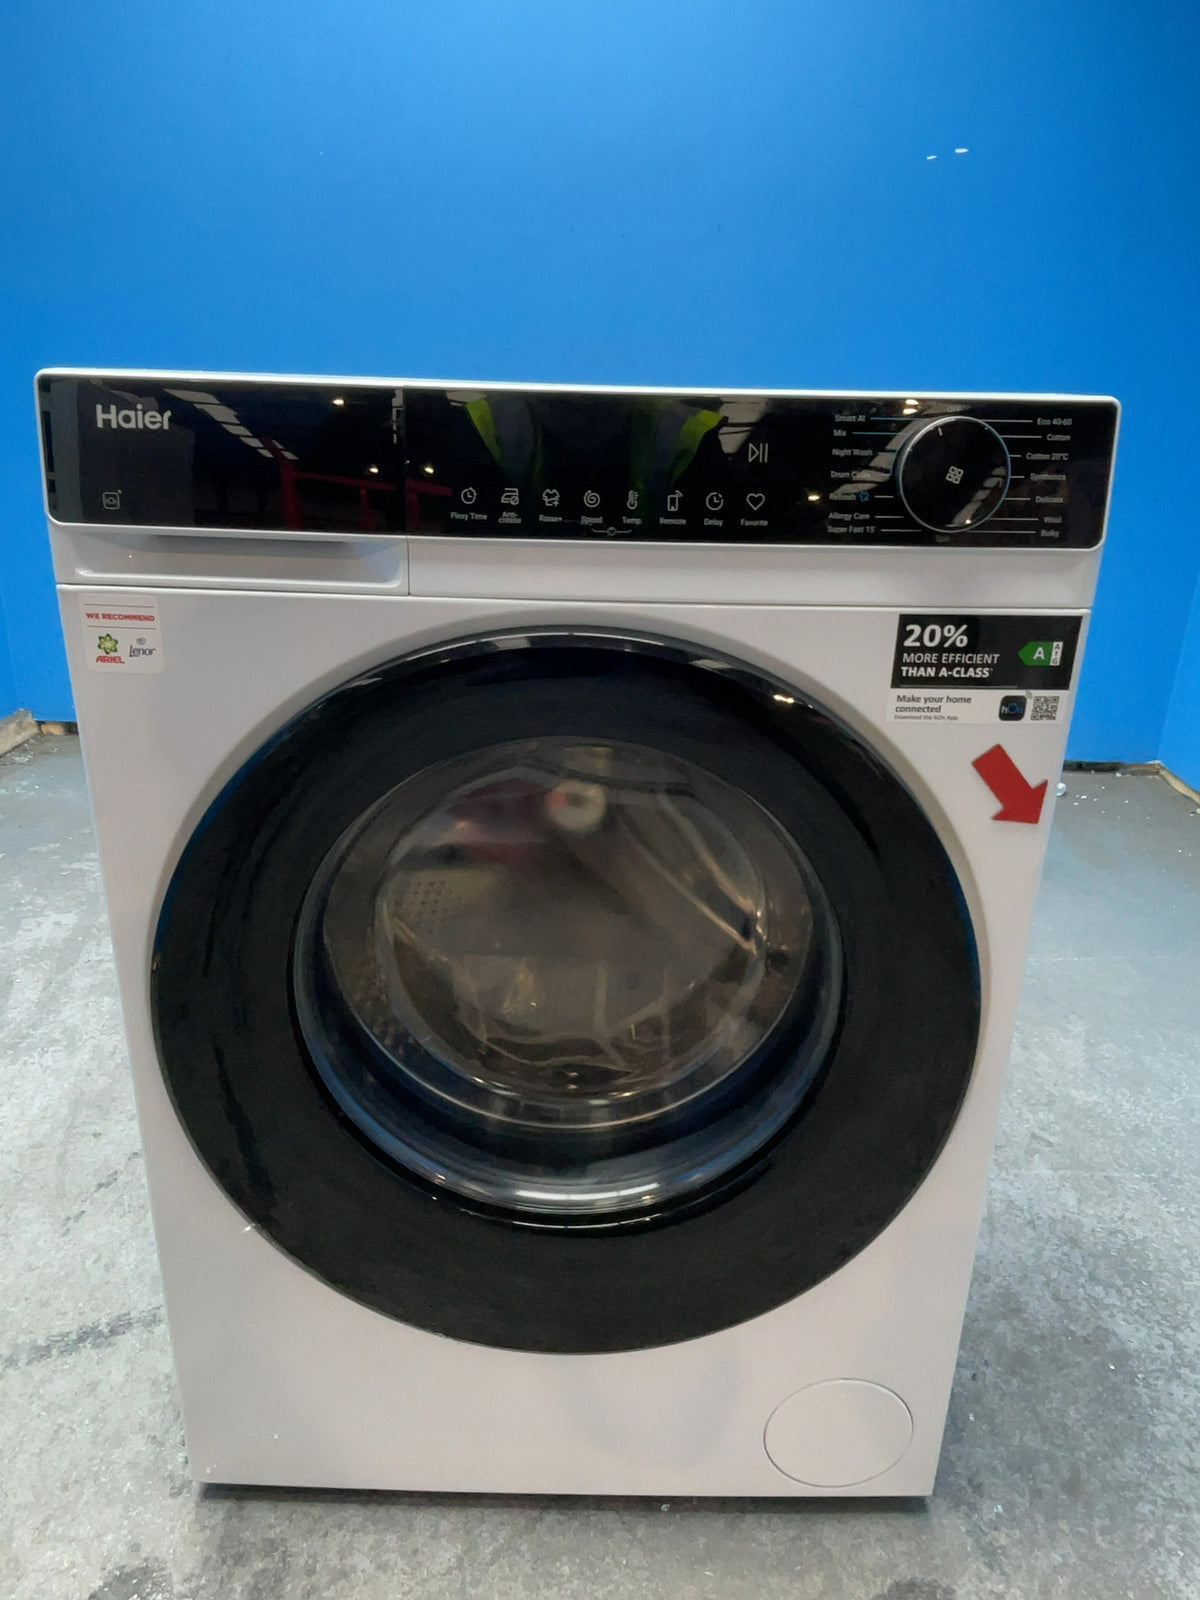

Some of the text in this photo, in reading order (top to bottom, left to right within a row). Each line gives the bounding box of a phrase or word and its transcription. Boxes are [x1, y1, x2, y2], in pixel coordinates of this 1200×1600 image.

[95, 403, 172, 430] Haier
[1037, 418, 1073, 426] Eco 40-60
[833, 429, 847, 437] Mix
[832, 448, 852, 457] Night
[828, 512, 852, 521] Allergy
[704, 518, 723, 527] Delay
[827, 526, 847, 534] Super
[1041, 529, 1060, 538] Bulky
[85, 612, 155, 622] WE RECOMMEND
[903, 624, 969, 648] 20%
[129, 645, 156, 658] Lenor
[1033, 646, 1045, 660] A
[96, 655, 125, 664] ARIEL
[902, 652, 1000, 664] MORE EFFICIENT
[901, 666, 936, 678] THAN
[896, 695, 972, 705] Make your home
[895, 705, 942, 713] connected
